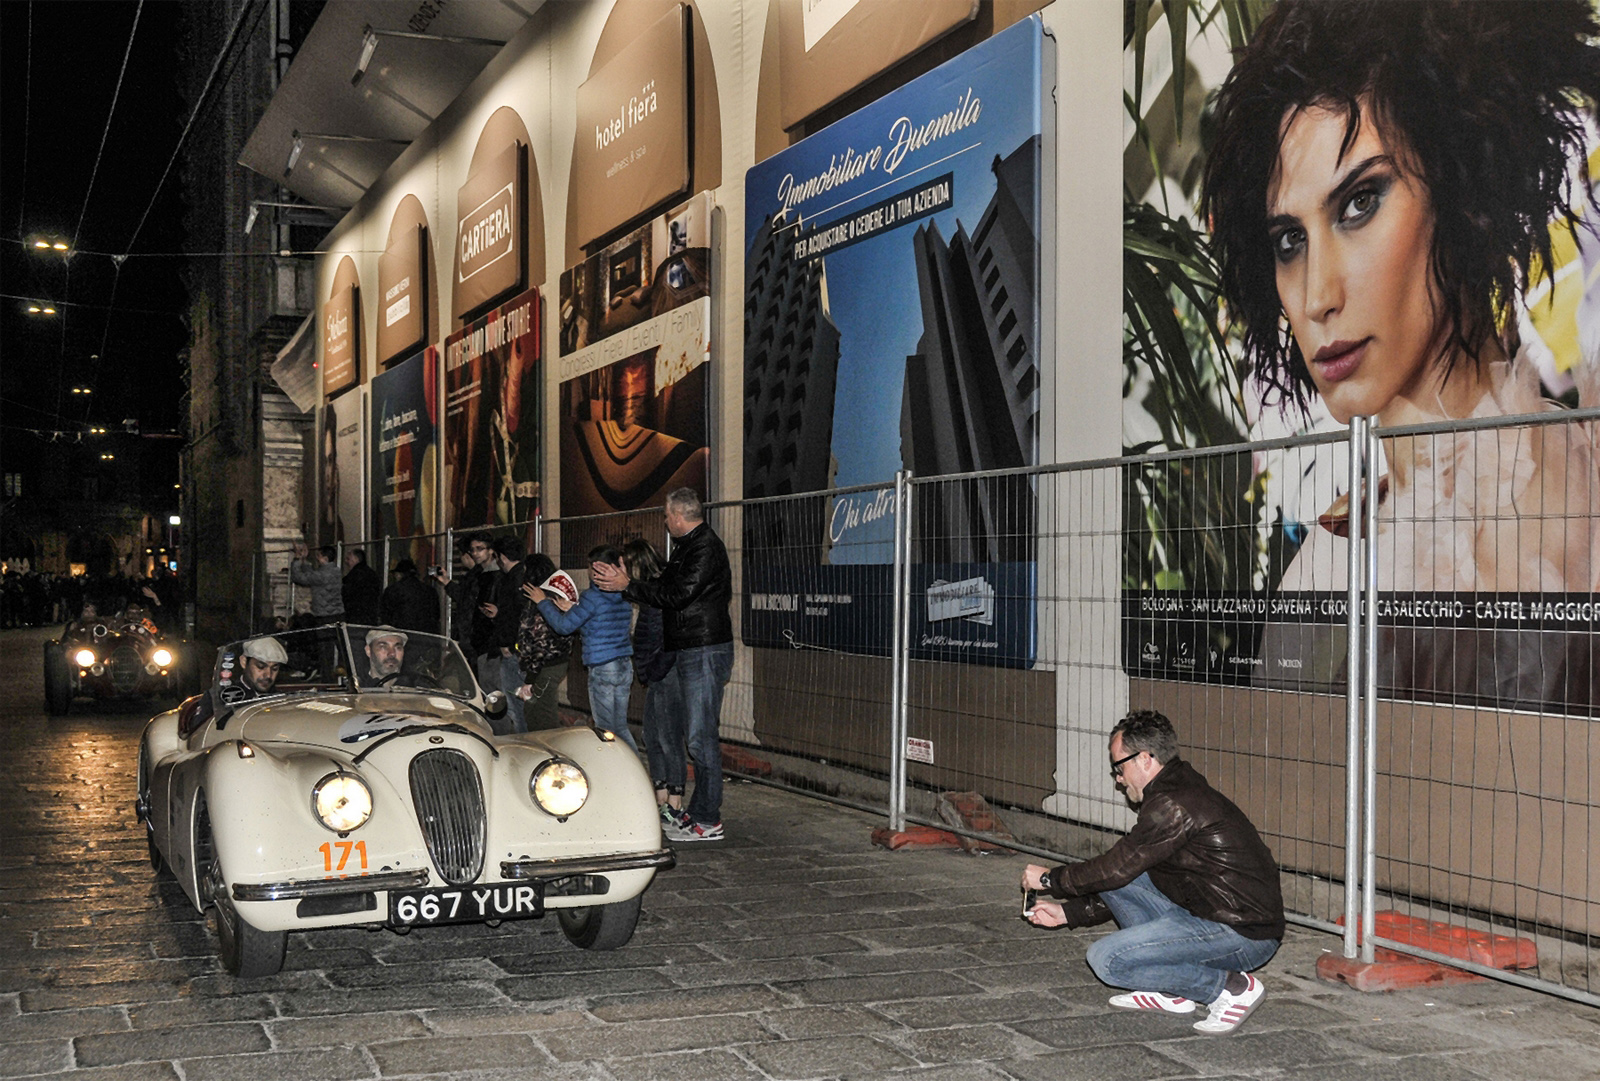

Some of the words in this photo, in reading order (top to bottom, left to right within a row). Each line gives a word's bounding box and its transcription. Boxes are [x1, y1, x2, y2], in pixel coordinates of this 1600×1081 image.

[596, 105, 625, 151] hotel
[628, 92, 658, 127] fiera
[772, 146, 882, 228] Immobiliare
[884, 87, 982, 175] Duemila
[794, 239, 807, 261] PER
[808, 222, 848, 254] ACQUISTARE
[850, 222, 854, 238] O
[856, 208, 884, 236] CEDERE
[885, 204, 895, 222] LA
[897, 196, 913, 219] TUA
[914, 181, 949, 214] AZIENDA
[829, 498, 860, 542] Chi
[1142, 596, 1184, 612] BOLOGNA
[1191, 597, 1209, 613] SAN
[1211, 598, 1256, 614] LAZZARO
[1271, 598, 1312, 616] SAVENA
[1377, 600, 1463, 618] CASALECCHIO
[1475, 600, 1526, 620] CASTEL
[318, 840, 368, 872] 171
[397, 891, 462, 922] 667
[472, 886, 536, 916] YUR
